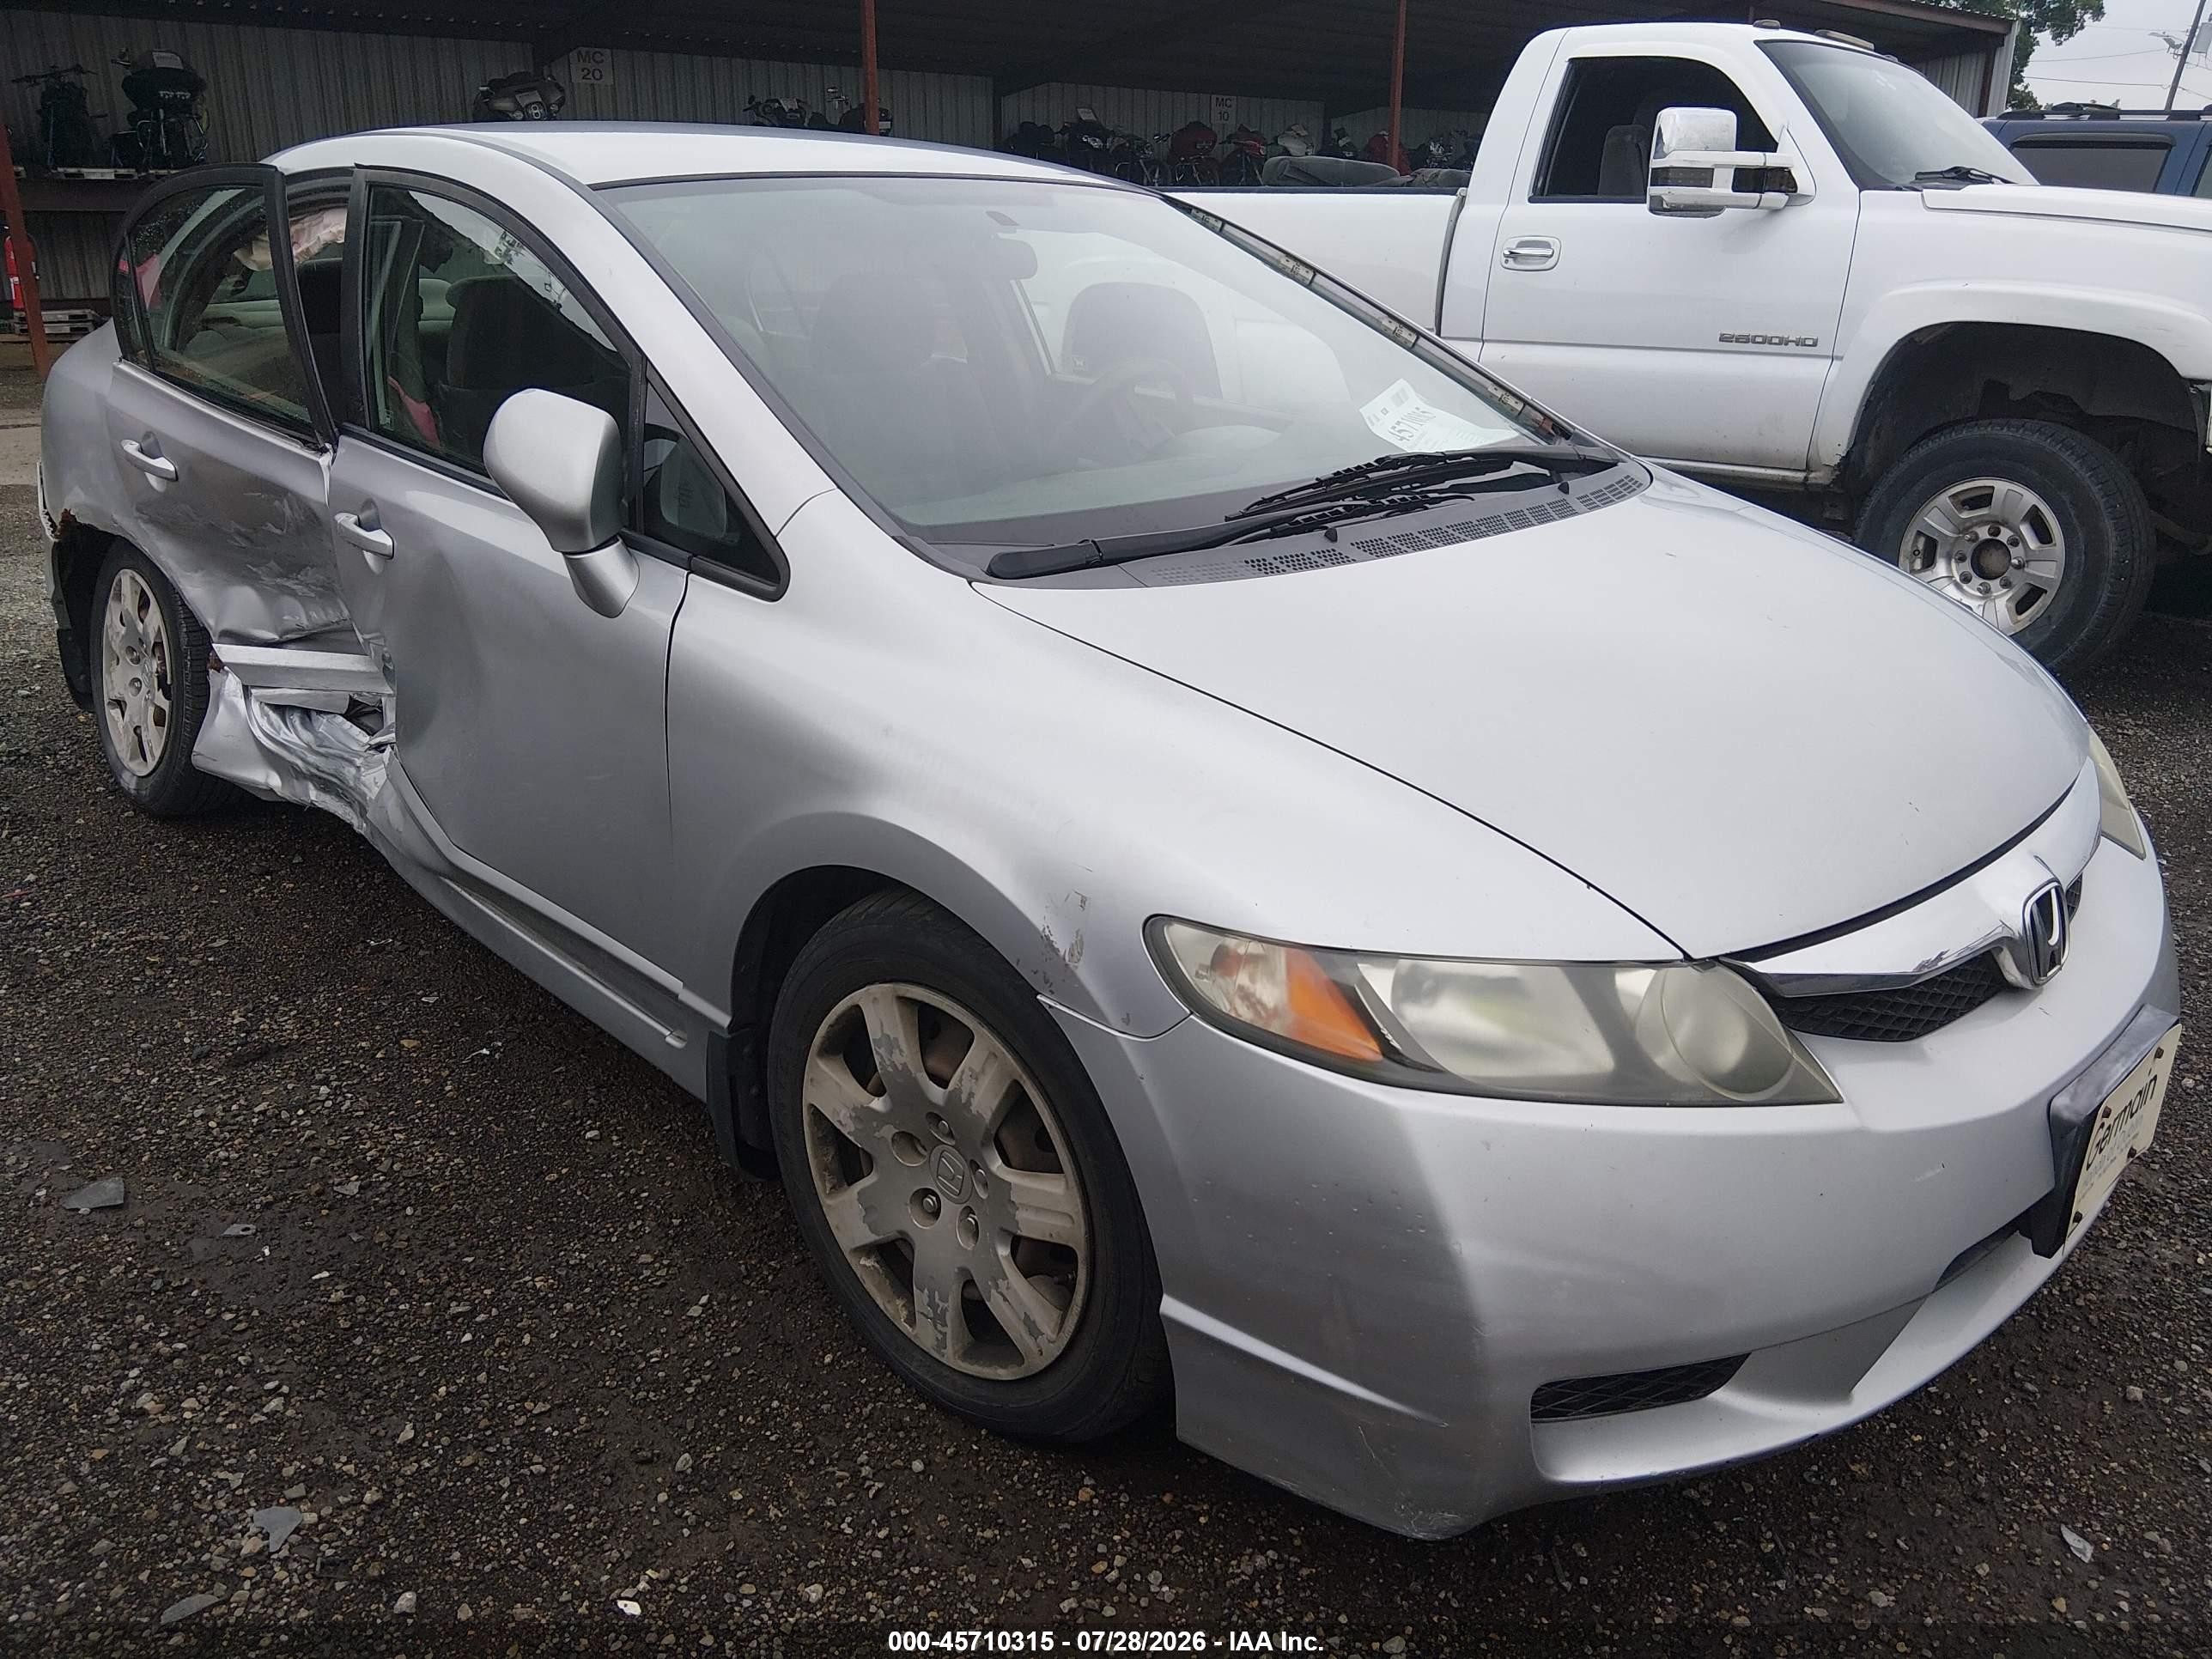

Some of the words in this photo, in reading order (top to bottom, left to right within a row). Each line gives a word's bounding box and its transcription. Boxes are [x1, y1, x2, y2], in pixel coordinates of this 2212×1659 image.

[577, 51, 605, 64] MC
[581, 67, 604, 81] 20
[1215, 97, 1232, 108] MC
[1218, 111, 1230, 121] 10
[2086, 1067, 2158, 1171] Germain
